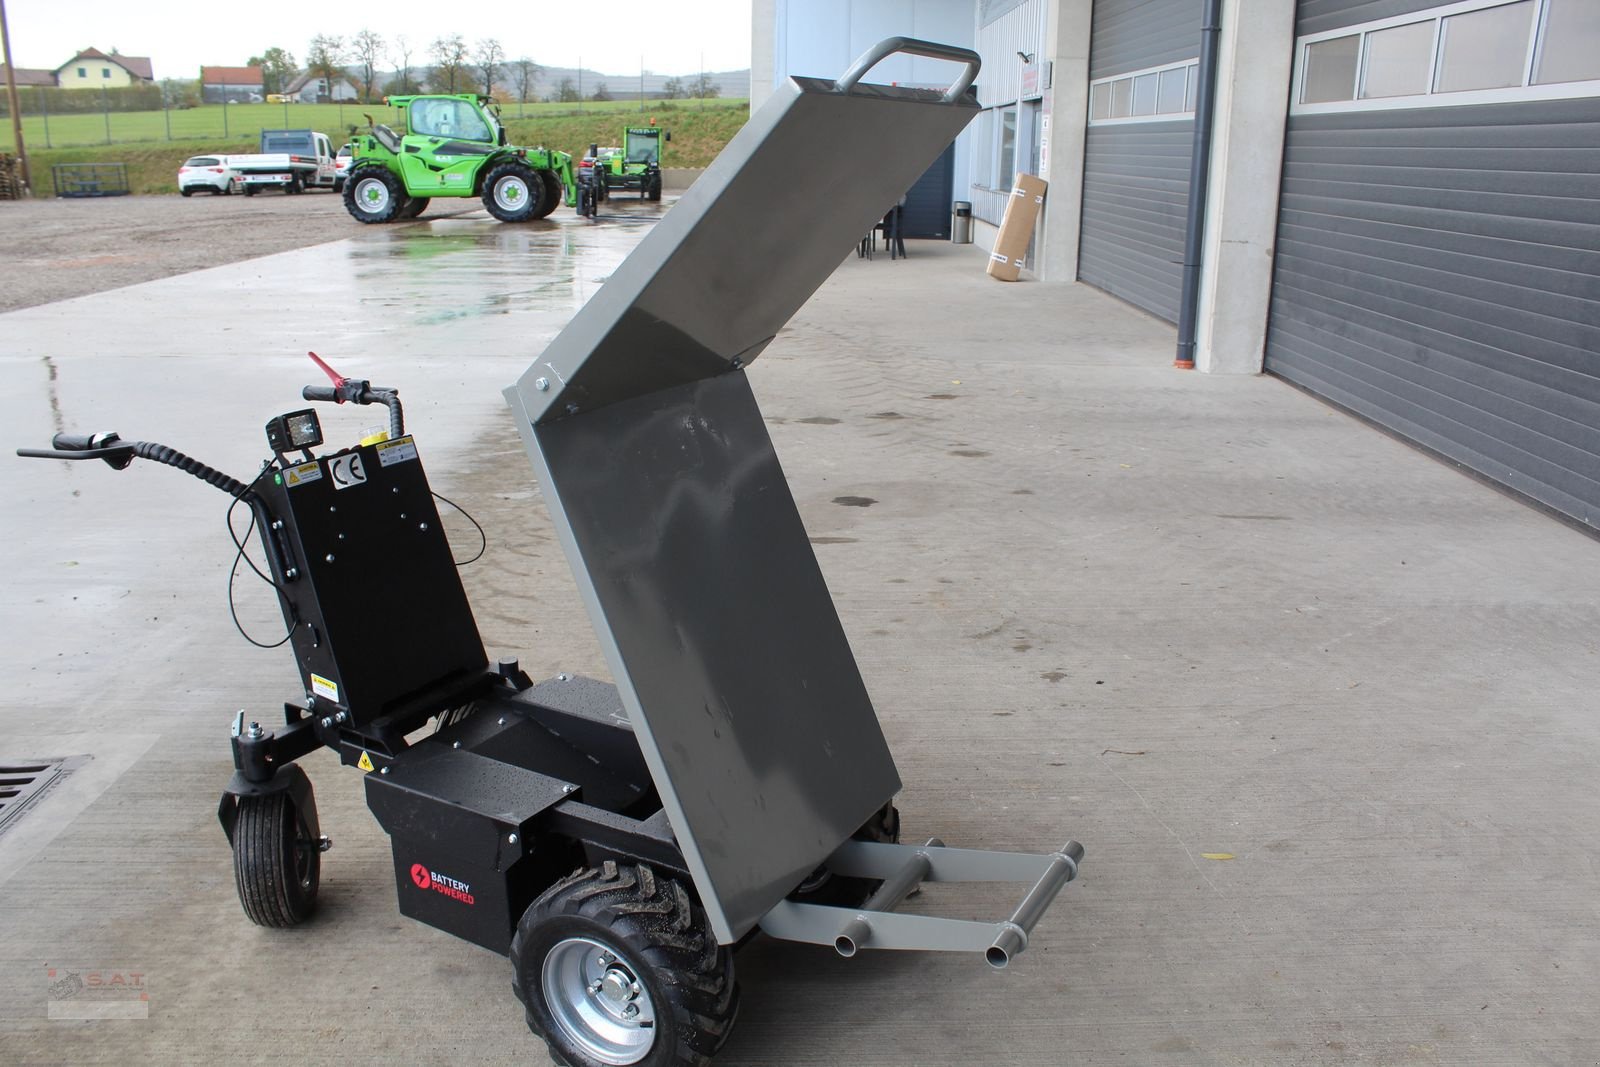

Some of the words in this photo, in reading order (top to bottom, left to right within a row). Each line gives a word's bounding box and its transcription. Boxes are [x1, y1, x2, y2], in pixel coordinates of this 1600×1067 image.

[333, 455, 364, 485] CE
[431, 871, 469, 893] BATTERY
[432, 881, 474, 905] POWERED
